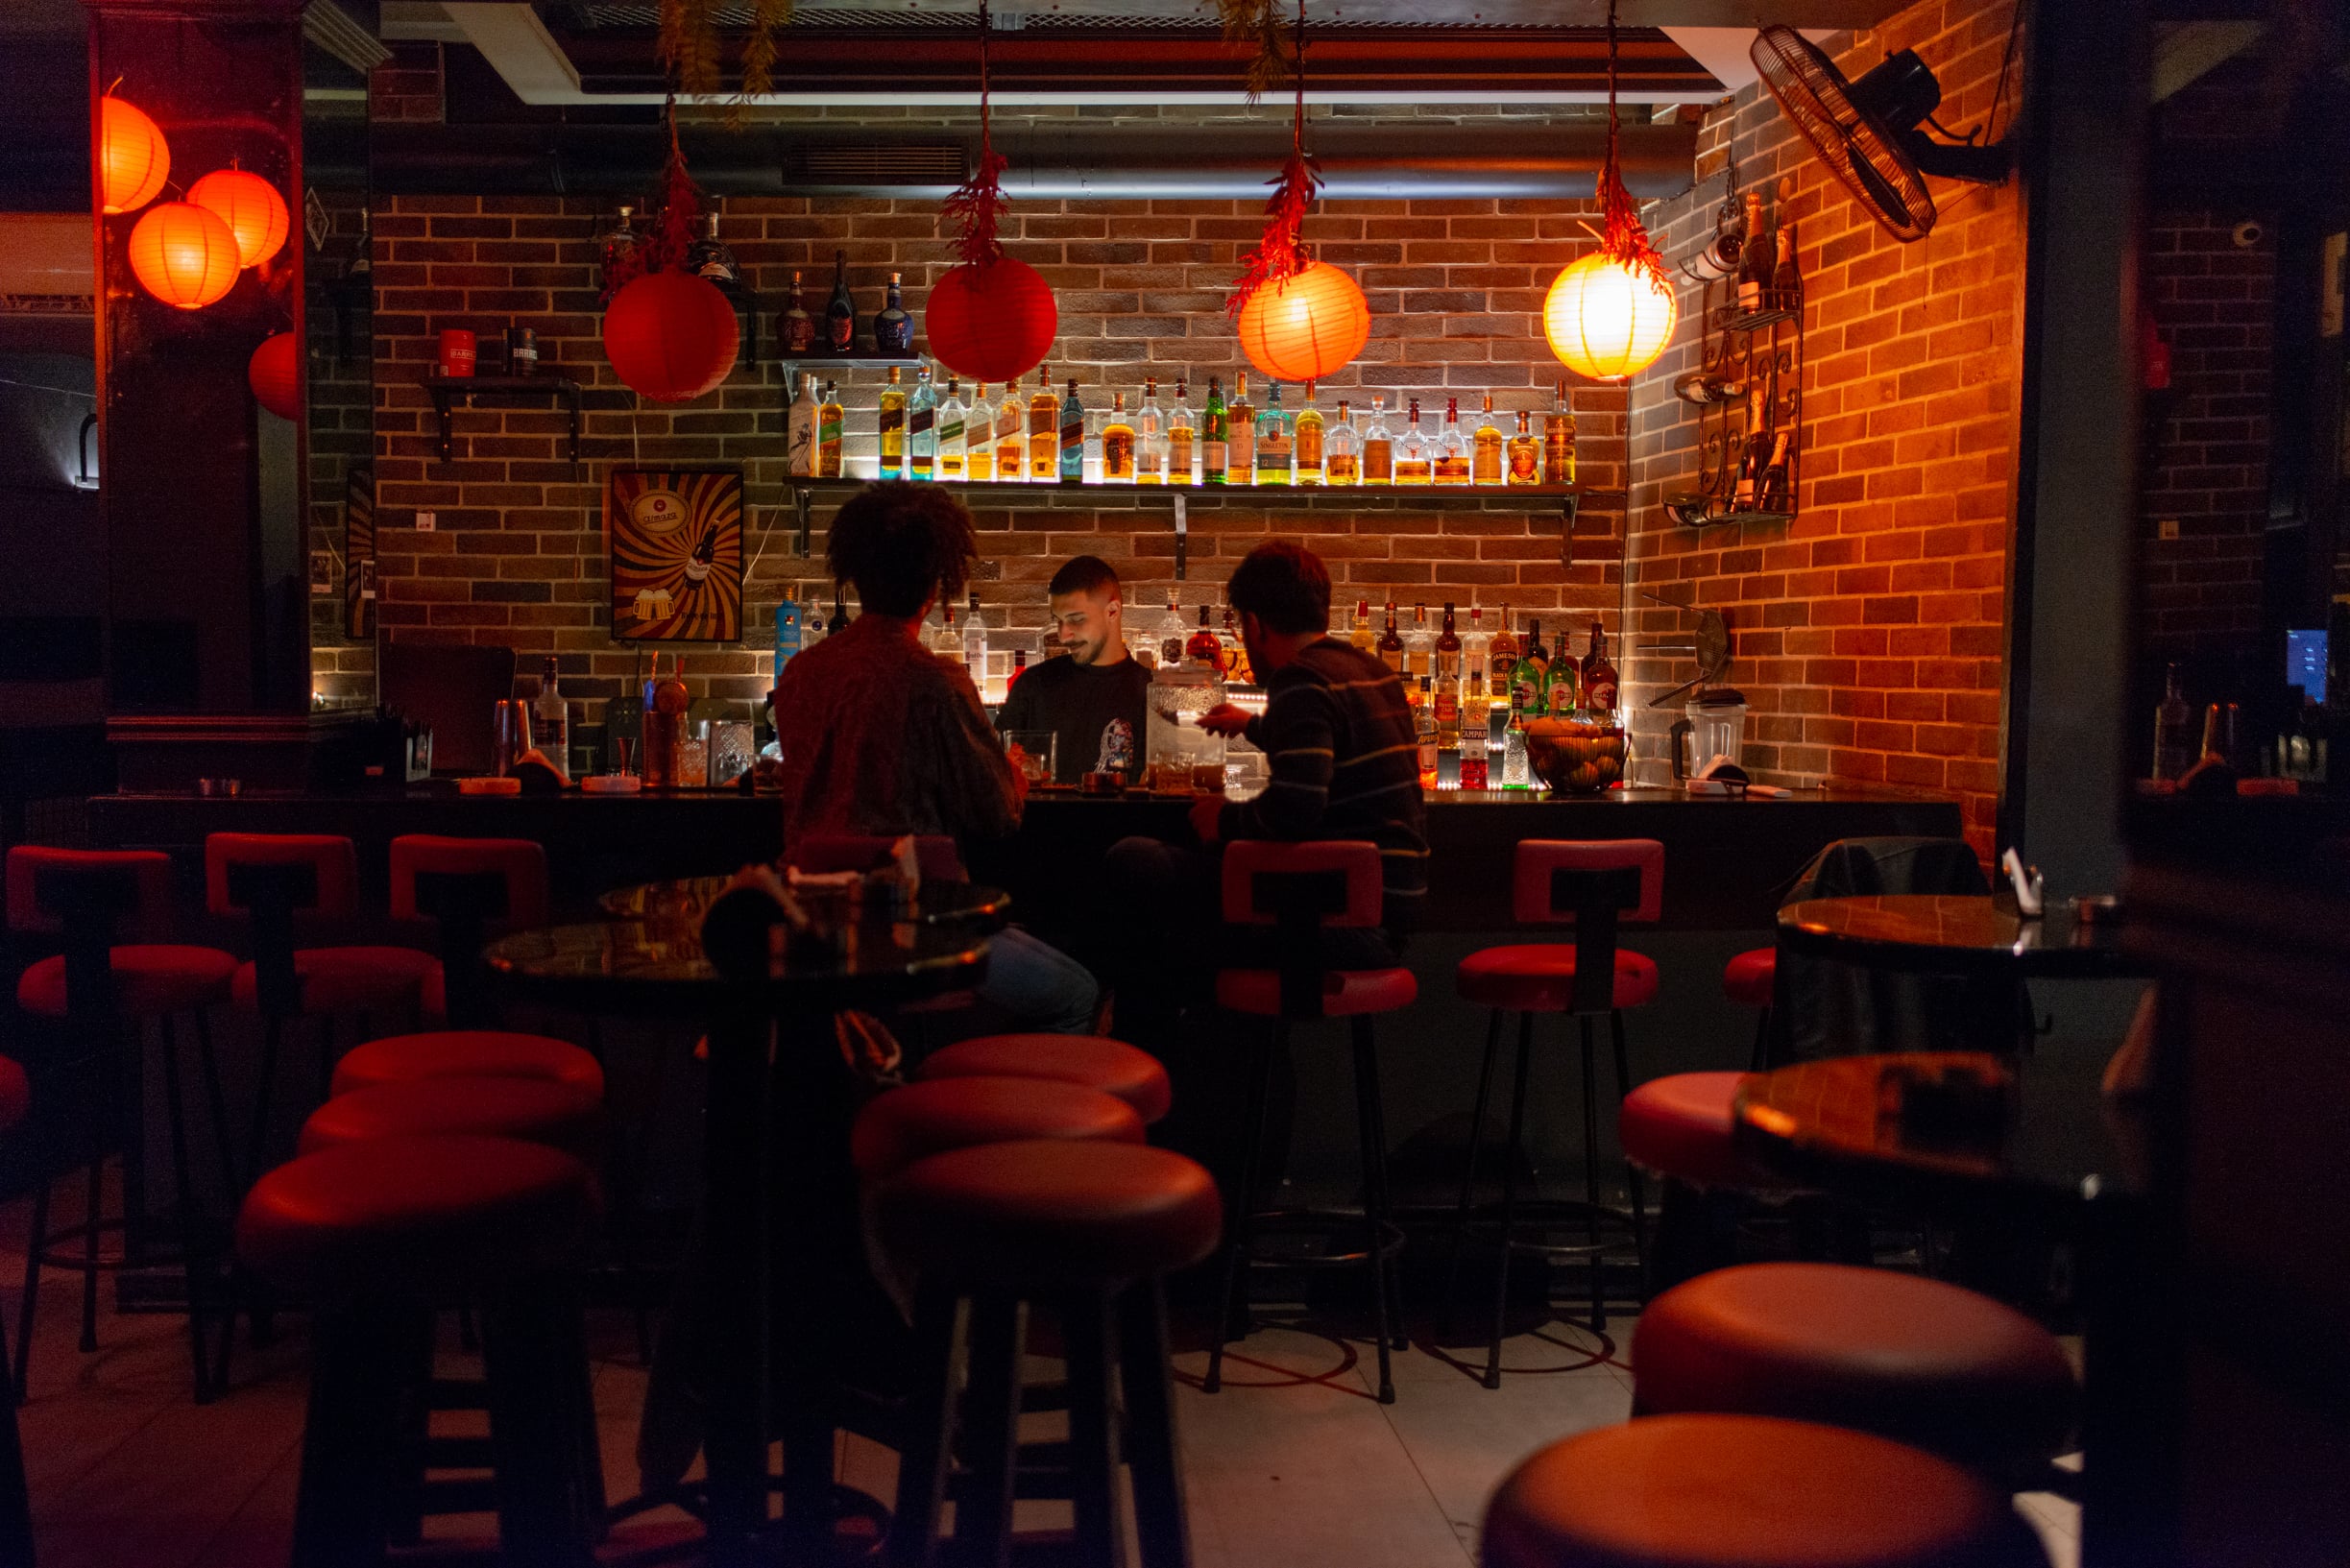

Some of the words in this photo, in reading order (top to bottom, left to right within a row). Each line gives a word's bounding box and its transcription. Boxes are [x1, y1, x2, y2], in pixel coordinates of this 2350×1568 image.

[1261, 458, 1269, 467] 12
[642, 512, 677, 523] almaza
[1492, 652, 1516, 662] JAMESON
